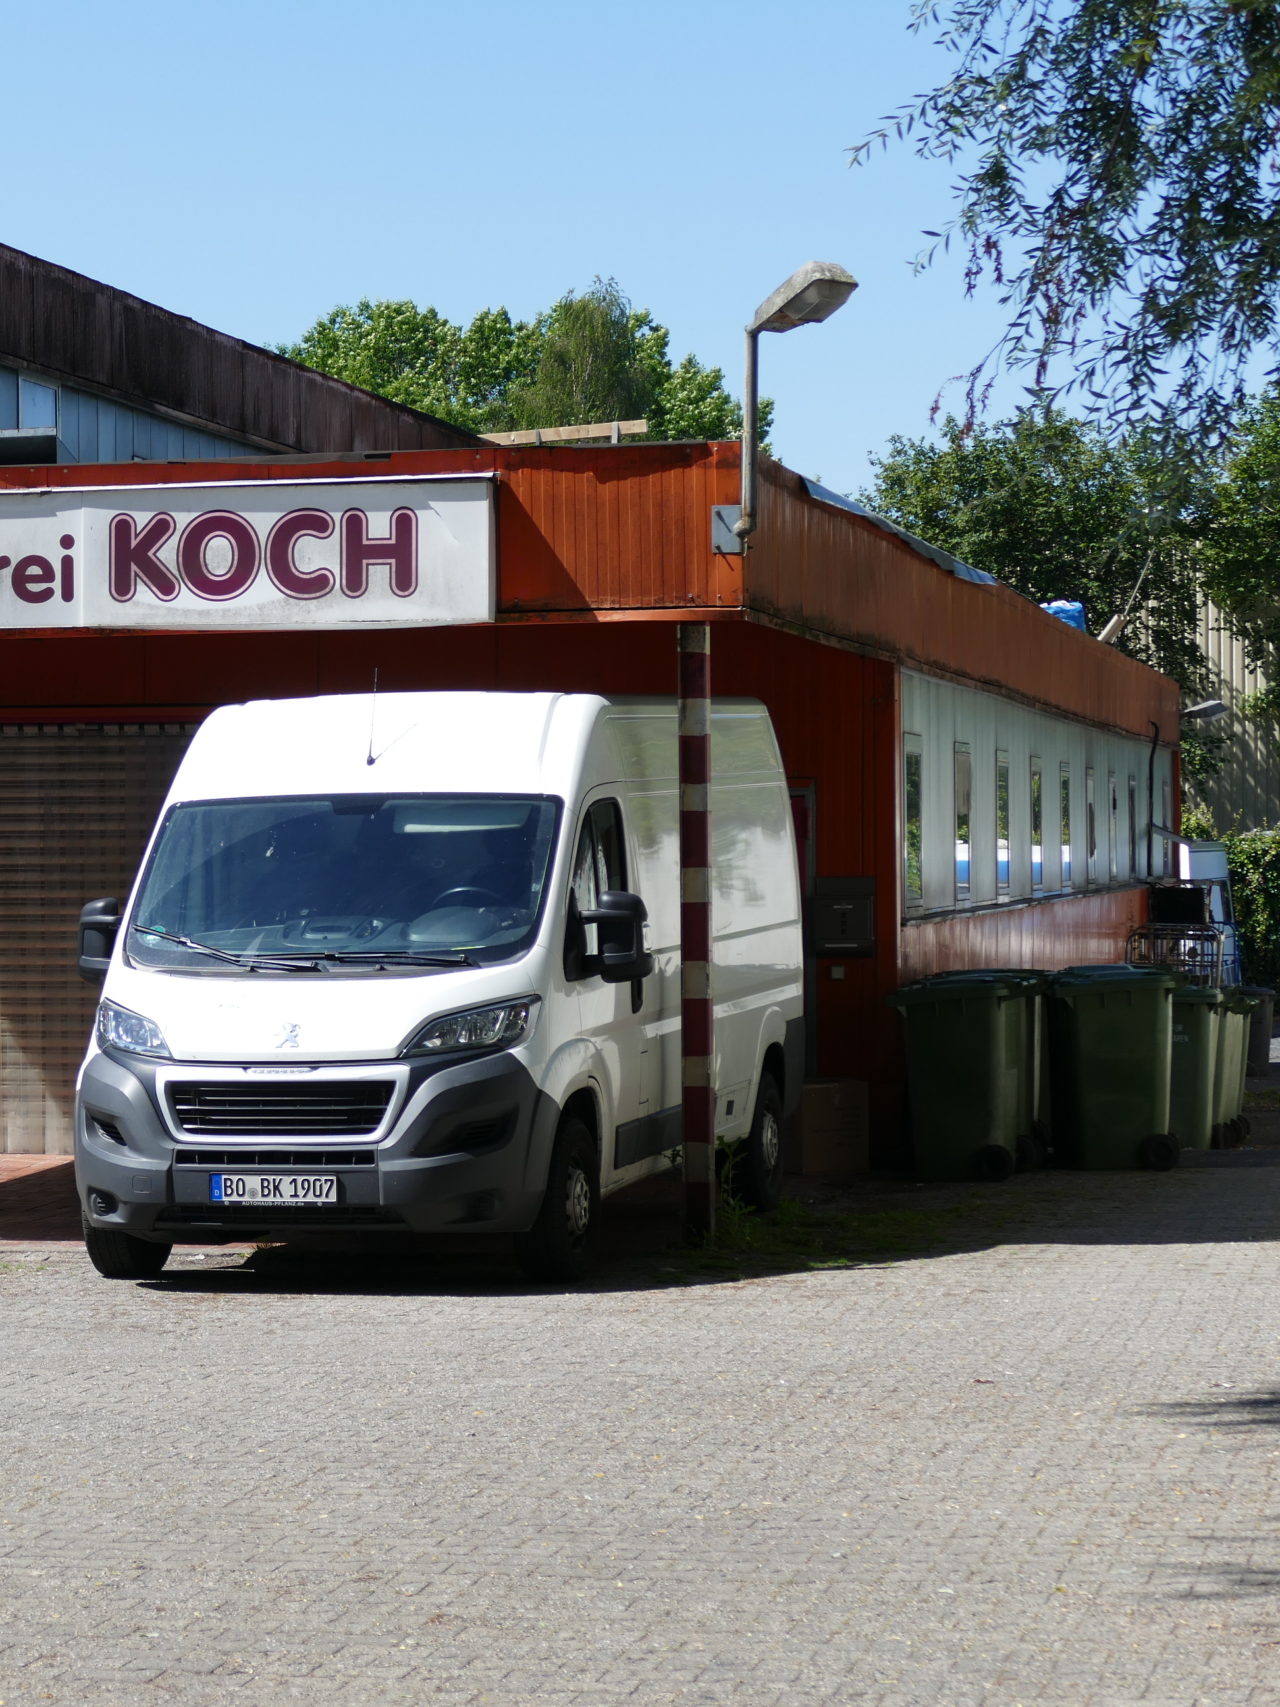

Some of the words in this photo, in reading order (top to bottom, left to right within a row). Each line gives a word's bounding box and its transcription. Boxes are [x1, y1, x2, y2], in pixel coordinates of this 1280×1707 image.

[108, 506, 419, 602] KOCH
[223, 1177, 246, 1198] BO
[260, 1177, 284, 1198] BK
[289, 1178, 335, 1199] 1907
